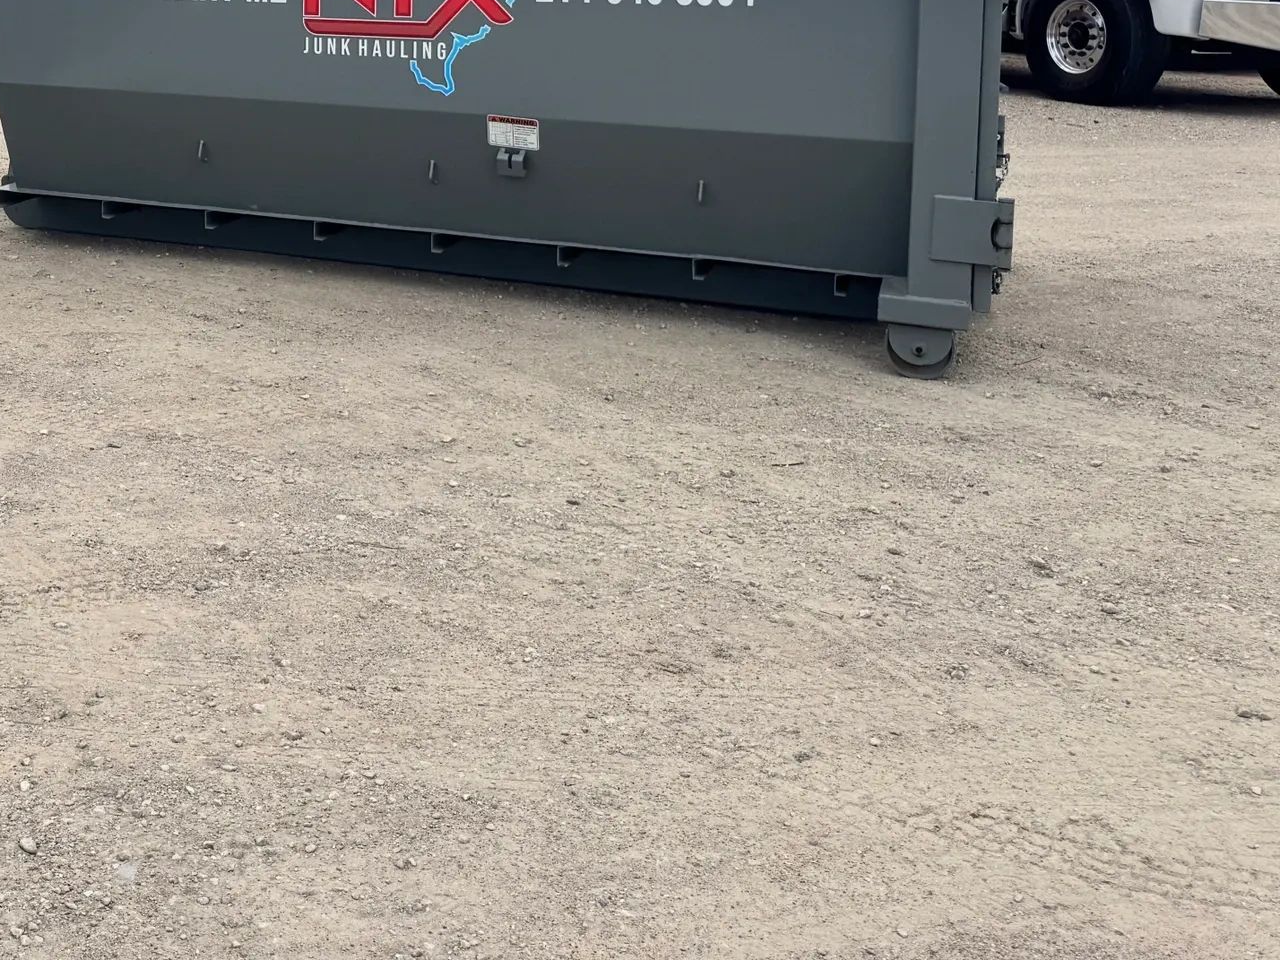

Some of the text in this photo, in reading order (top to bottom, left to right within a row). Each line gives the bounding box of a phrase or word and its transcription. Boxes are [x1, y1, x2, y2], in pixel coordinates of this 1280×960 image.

[303, 36, 447, 60] JUNK HAULING
[499, 117, 537, 127] WARNING
